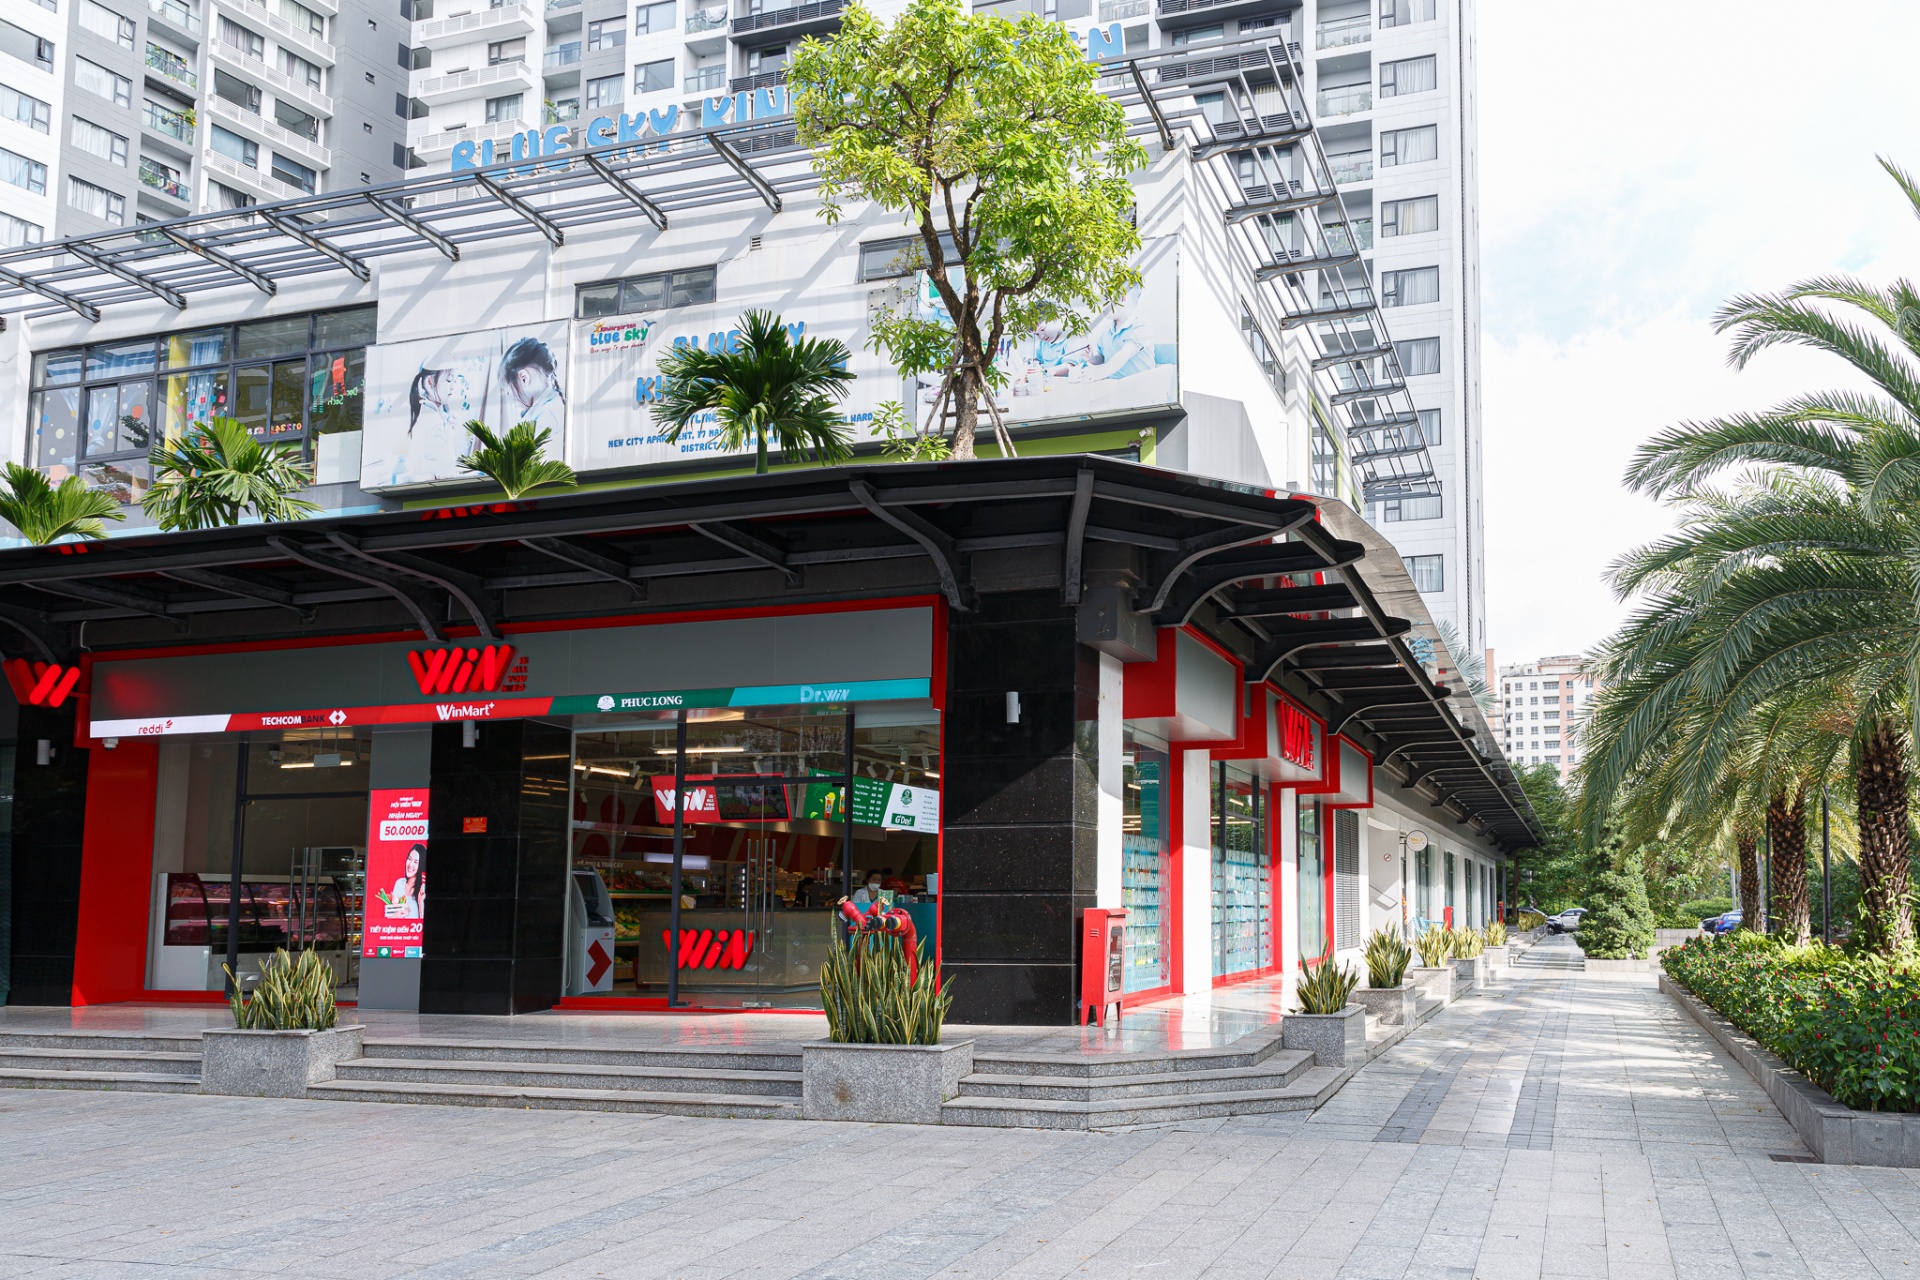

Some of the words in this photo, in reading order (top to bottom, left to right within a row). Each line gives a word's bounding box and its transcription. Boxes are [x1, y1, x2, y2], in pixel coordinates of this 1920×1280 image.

[451, 124, 574, 182] BLUE
[586, 104, 684, 162] SKY
[625, 437, 645, 447] CITY
[681, 441, 718, 453] DISTRICT
[652, 695, 683, 706] LONG
[262, 714, 326, 726] TECHCOMBANK
[138, 724, 164, 735] reddi
[384, 825, 426, 836] 50.000Đ
